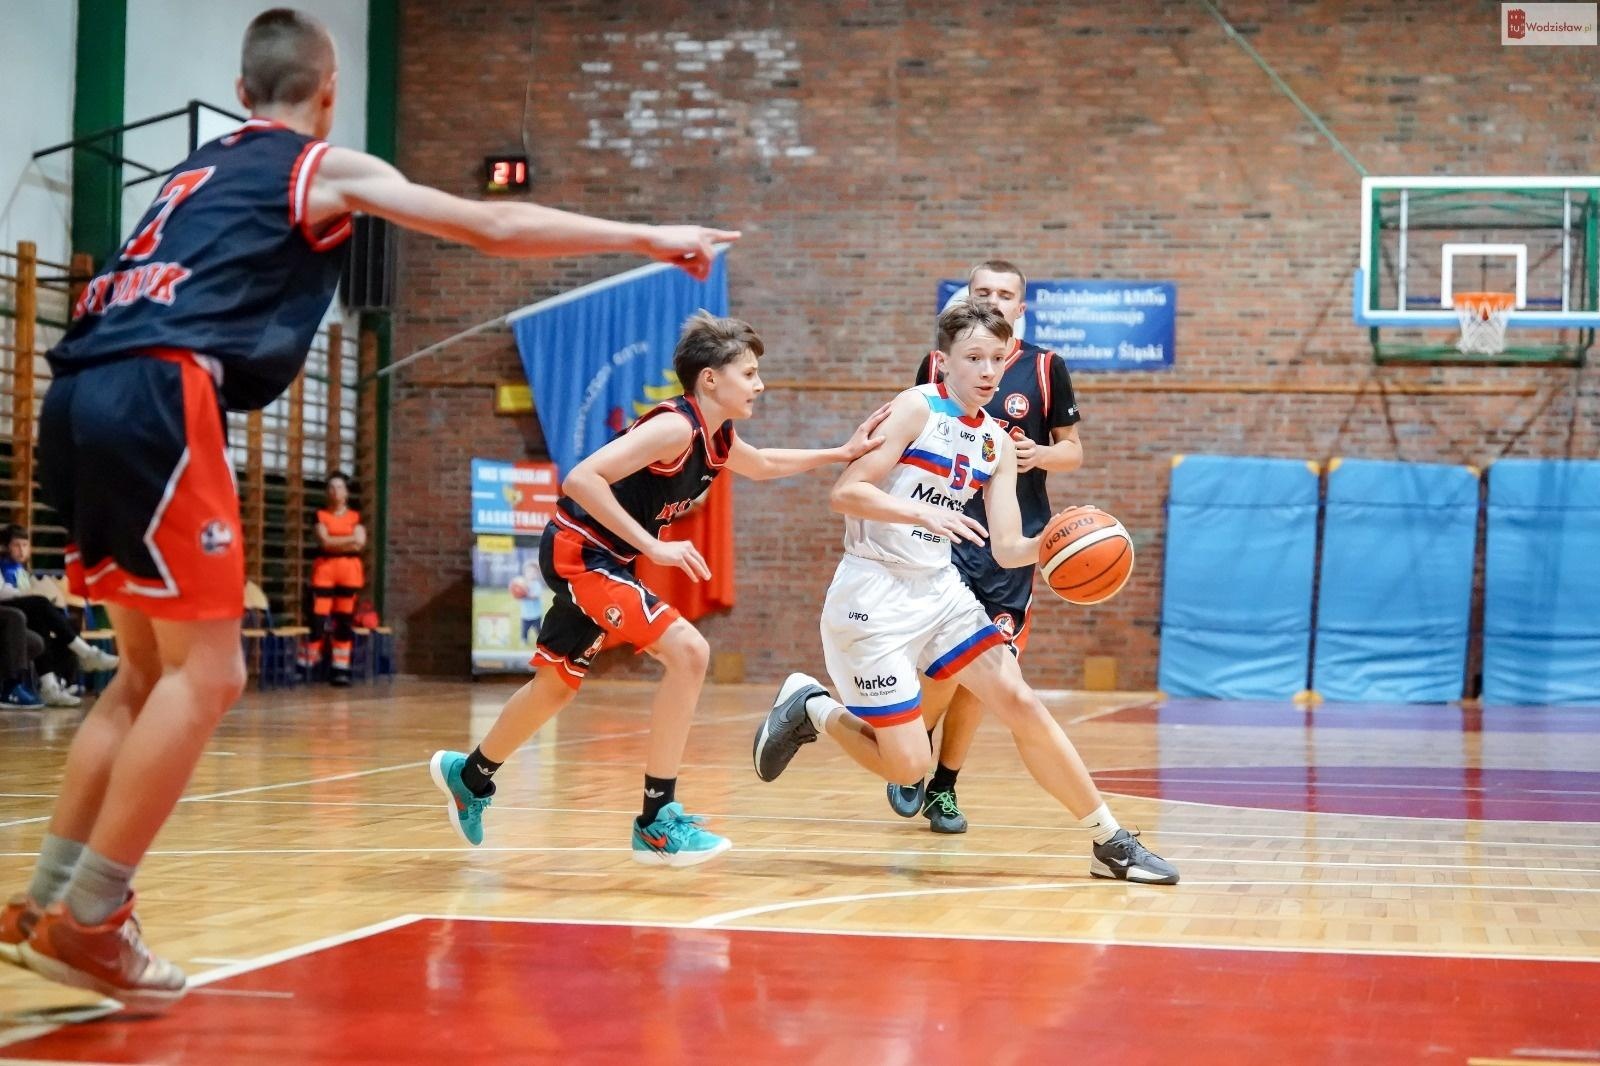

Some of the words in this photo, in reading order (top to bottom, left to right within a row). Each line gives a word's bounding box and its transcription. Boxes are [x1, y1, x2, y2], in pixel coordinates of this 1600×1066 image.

[493, 161, 525, 185] 21
[120, 165, 217, 261] 7
[1034, 326, 1086, 341] Miasto
[949, 453, 970, 490] 5
[1045, 517, 1095, 550] molten
[853, 674, 898, 691] Marko
